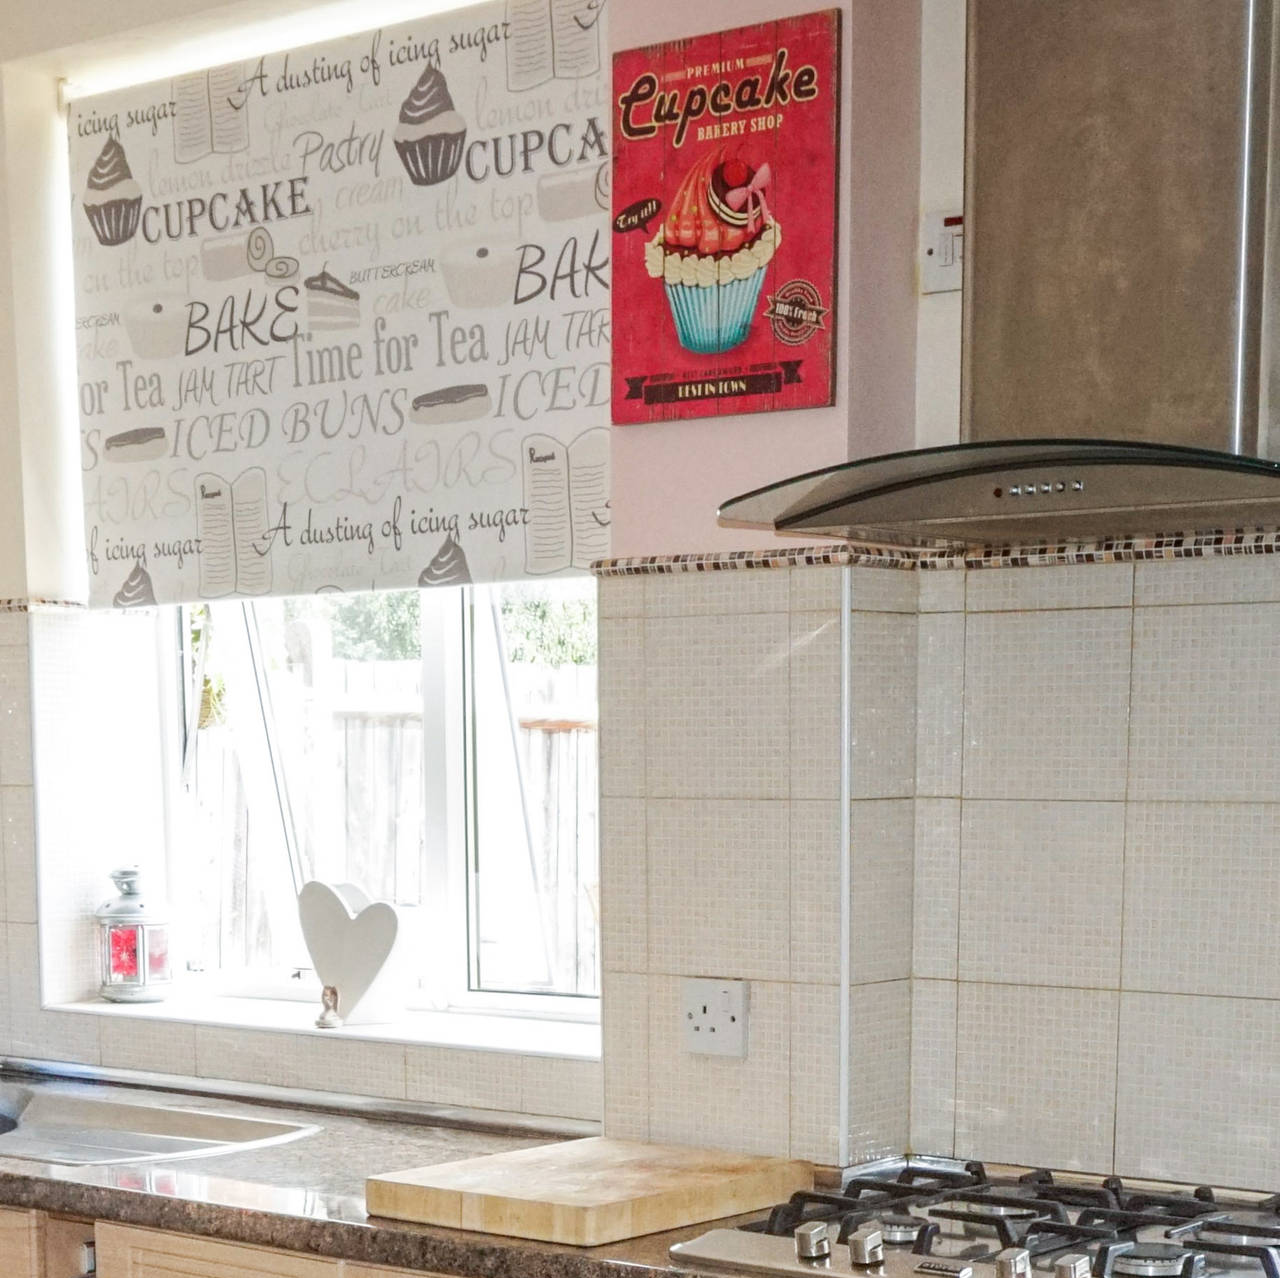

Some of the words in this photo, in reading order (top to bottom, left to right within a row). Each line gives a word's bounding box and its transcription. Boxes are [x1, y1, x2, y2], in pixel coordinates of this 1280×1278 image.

[275, 54, 353, 98] dusting
[361, 29, 382, 87] of
[389, 28, 441, 69] icing
[449, 18, 512, 63] sugar
[687, 58, 745, 79] PREMIUM
[77, 108, 120, 139] icing
[126, 98, 178, 137] sugar
[476, 75, 553, 132] lemon
[619, 47, 819, 148] Cupcake
[292, 119, 385, 179] Pastry
[697, 118, 747, 141] BAKERY
[750, 114, 784, 132] SHOP
[148, 148, 213, 199] lemon
[335, 177, 403, 209] cream
[141, 176, 313, 244] CUPCAKE
[299, 199, 381, 262] cherry
[391, 215, 425, 241] on
[434, 180, 478, 232] the
[488, 187, 534, 239] top
[162, 250, 201, 297] top
[349, 258, 437, 285] BUTTERCREAM
[374, 274, 432, 317] cake
[183, 284, 299, 357] BAKE
[496, 314, 559, 367] JAM
[287, 330, 362, 388] Time
[372, 315, 419, 377] for
[427, 310, 490, 368] Tea
[115, 359, 166, 411] Tea
[172, 366, 220, 412] JAM
[224, 356, 287, 399] TART
[492, 361, 610, 421] ICED
[678, 382, 702, 399] BEST
[704, 382, 716, 396] IN
[718, 380, 747, 395] TOWN
[169, 408, 270, 461] ICED
[282, 387, 408, 444] BUNS
[276, 427, 517, 505] ECLAIRS
[105, 536, 148, 569] icing
[153, 537, 205, 571] sugar
[251, 499, 295, 558] A
[299, 506, 376, 555] dusting
[380, 494, 402, 553] of
[410, 505, 461, 543] icing
[466, 506, 530, 544] sugar
